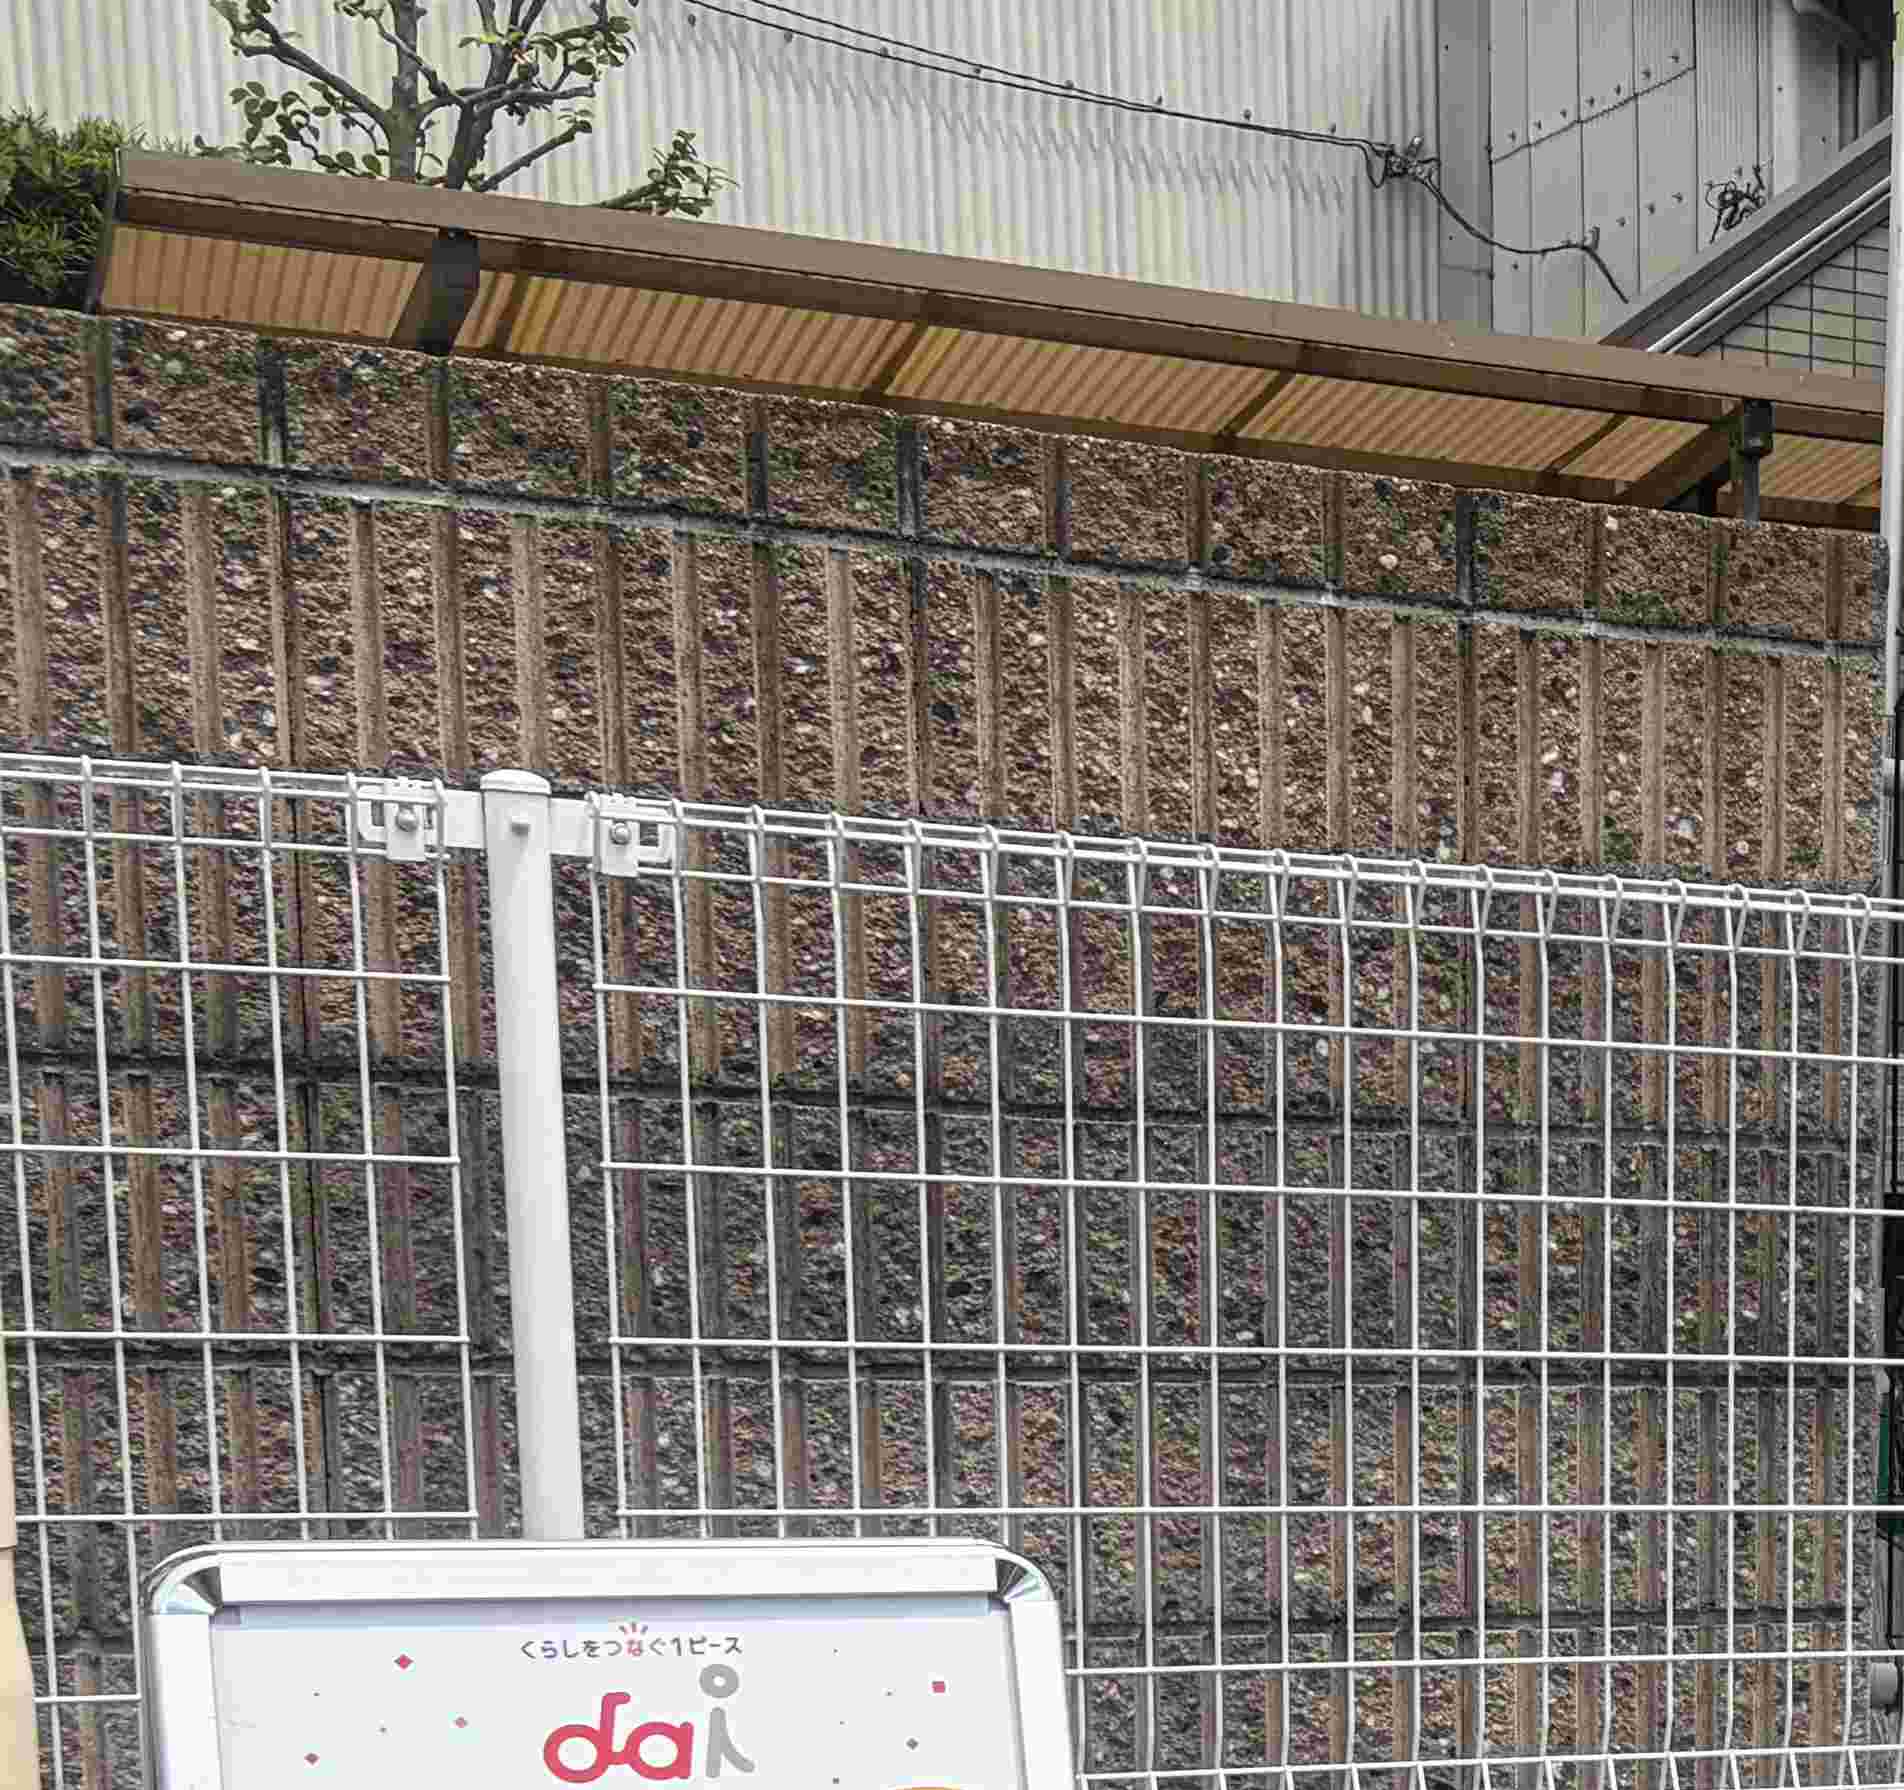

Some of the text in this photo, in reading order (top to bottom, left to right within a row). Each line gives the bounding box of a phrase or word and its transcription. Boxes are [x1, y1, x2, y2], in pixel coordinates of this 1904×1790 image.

[520, 1636, 743, 1660] くらしをつなぐ1ピース
[543, 1663, 755, 1783] dai
